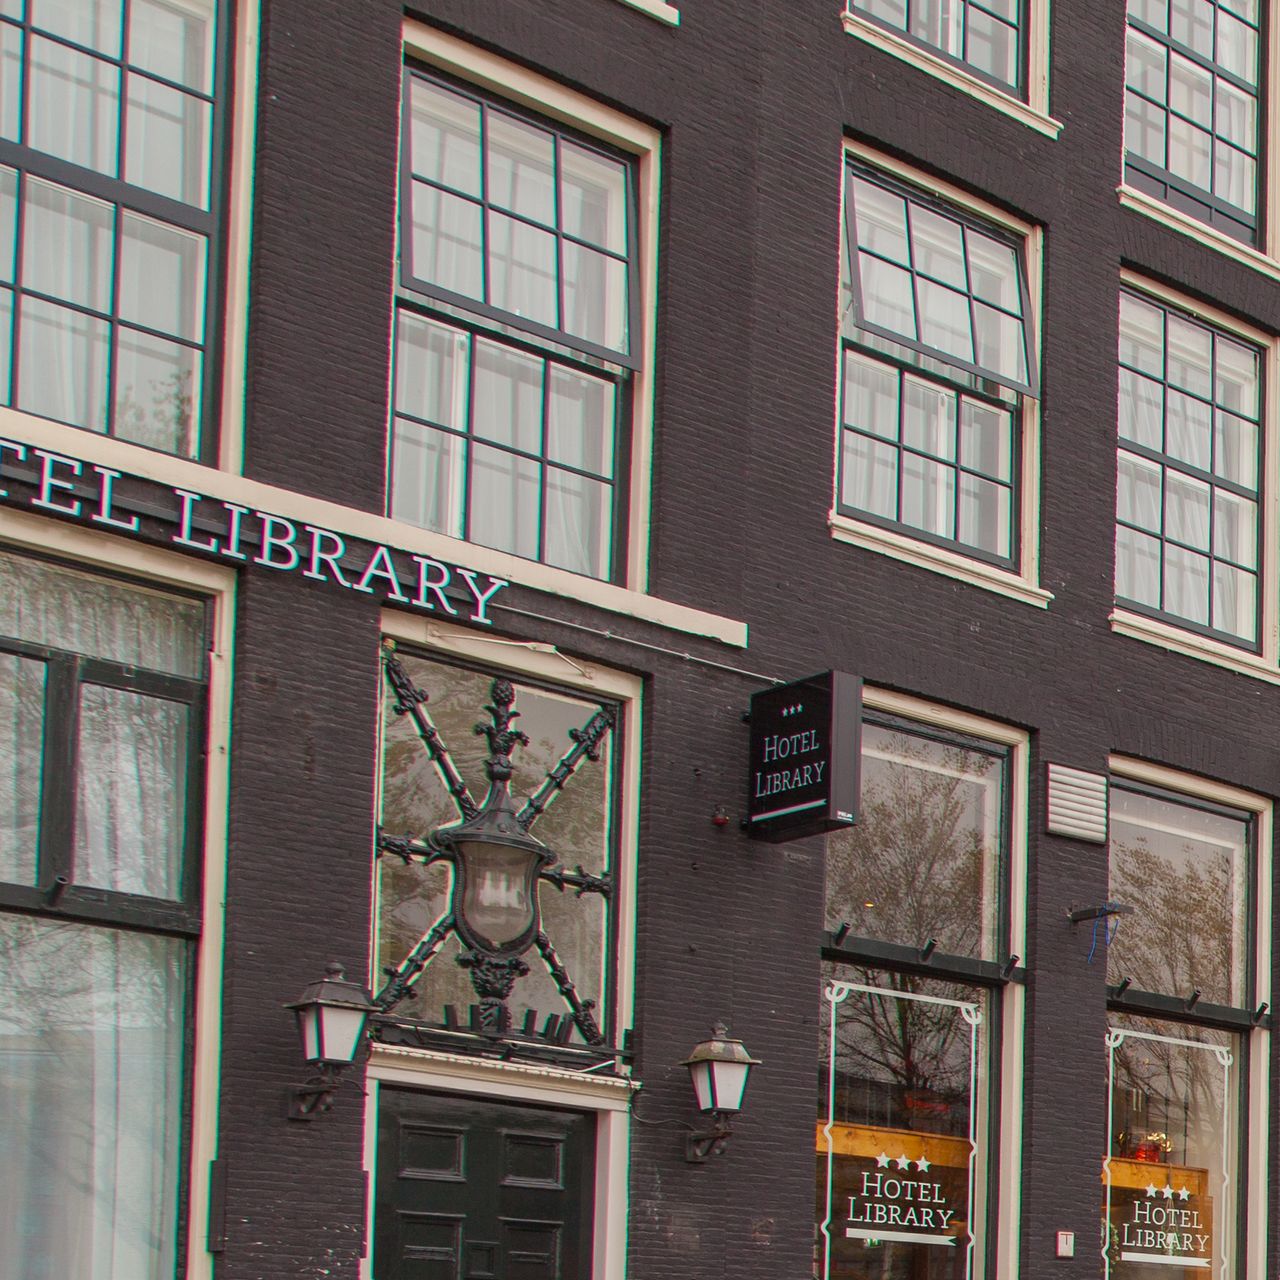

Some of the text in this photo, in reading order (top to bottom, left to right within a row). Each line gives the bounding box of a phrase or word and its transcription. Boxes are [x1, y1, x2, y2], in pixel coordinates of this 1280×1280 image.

[172, 488, 509, 626] LIBRARY
[763, 729, 820, 763] HOTEL
[755, 760, 826, 798] LIBRARY
[860, 1171, 946, 1204] HOTEL
[847, 1196, 954, 1229] LIBRARY
[1133, 1200, 1203, 1229] HOTEL
[1121, 1223, 1210, 1252] LIBRARY
